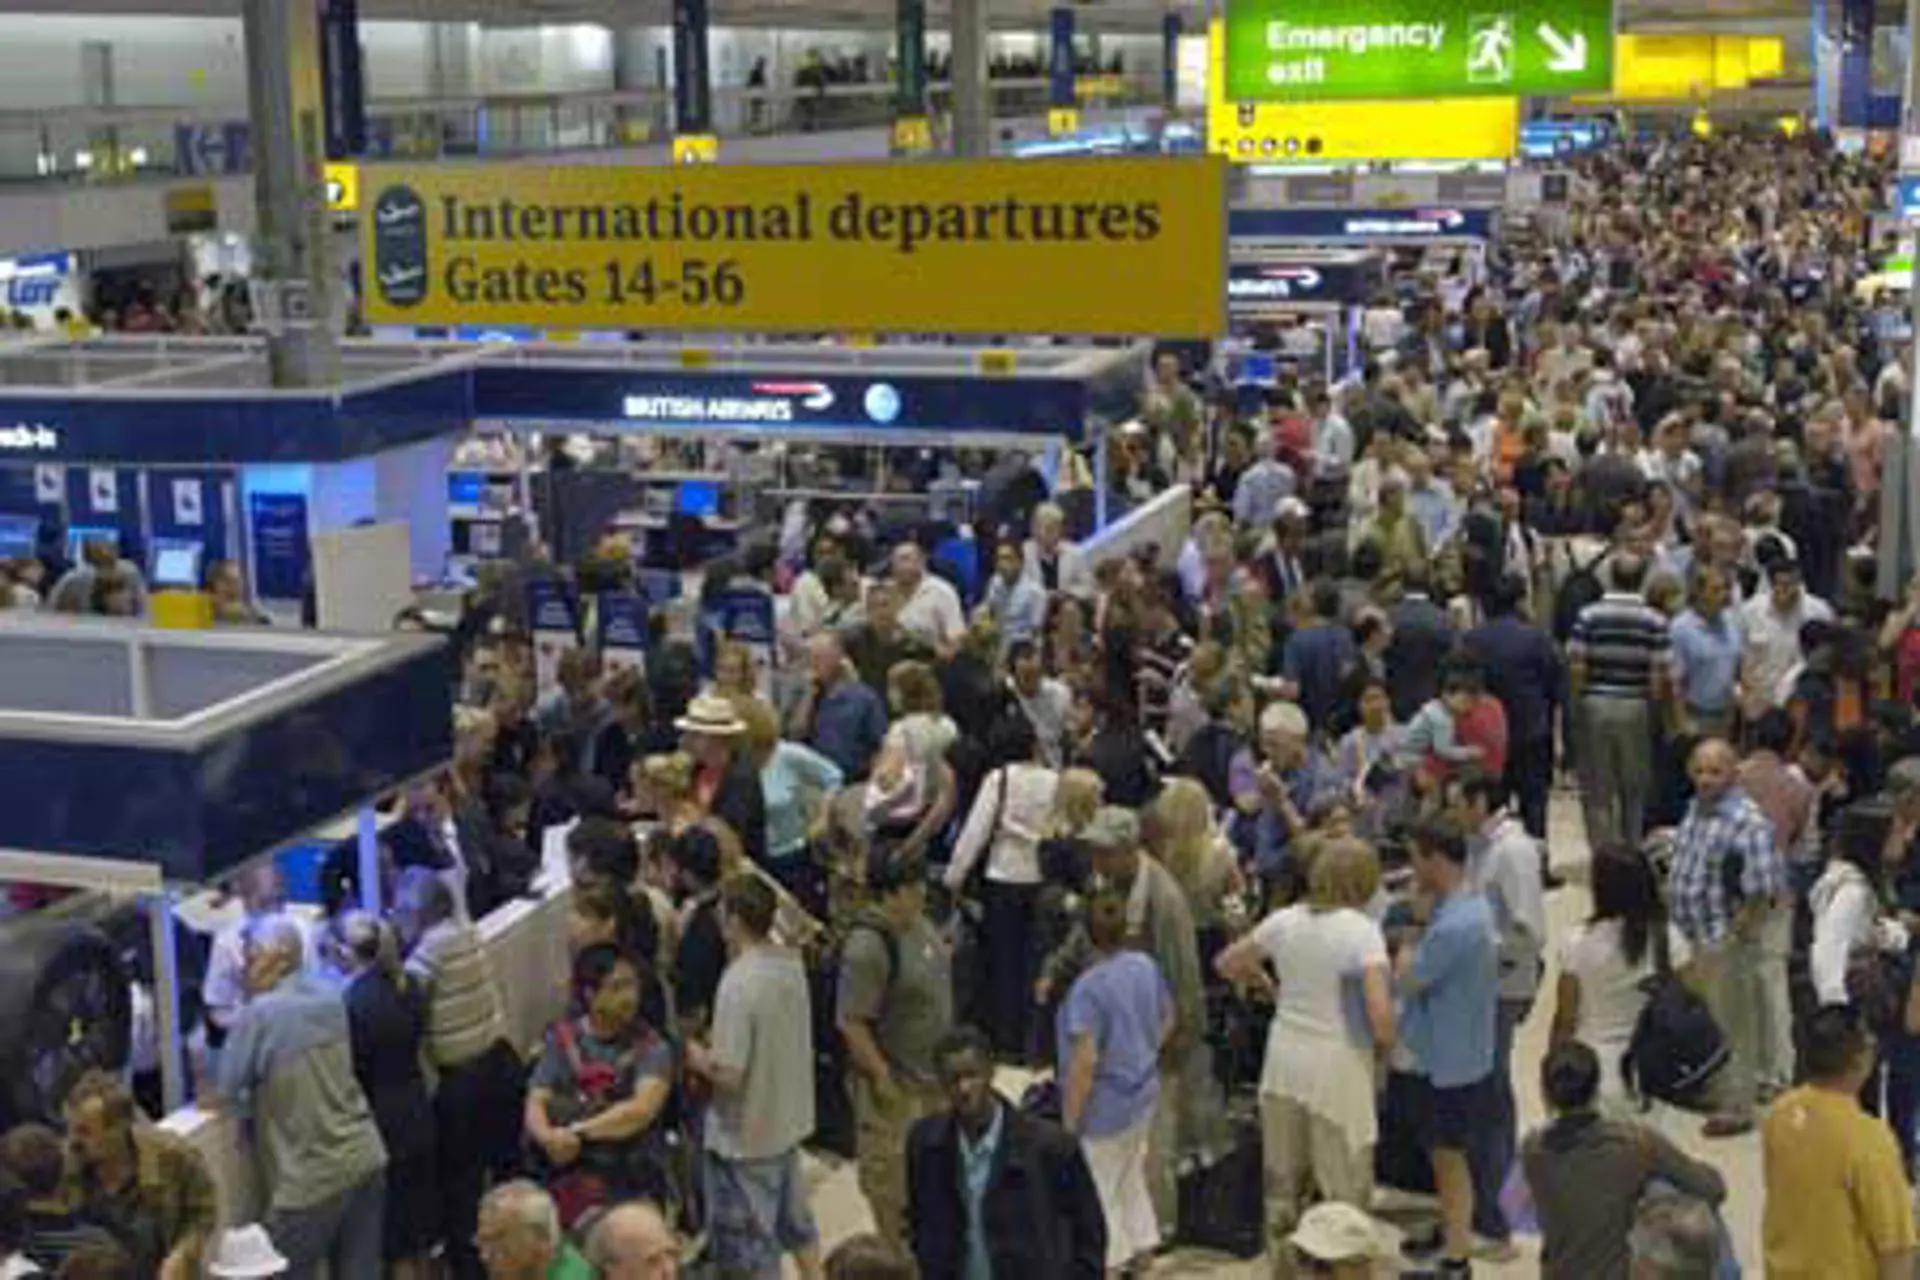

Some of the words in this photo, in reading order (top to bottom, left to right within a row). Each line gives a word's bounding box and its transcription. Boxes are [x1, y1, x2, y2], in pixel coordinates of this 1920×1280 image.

[1267, 21, 1445, 53] Emergency
[1267, 57, 1325, 84] exit
[440, 192, 811, 240] International
[828, 191, 1162, 253] departures
[443, 256, 587, 304] Gates
[604, 257, 744, 305] 14-56
